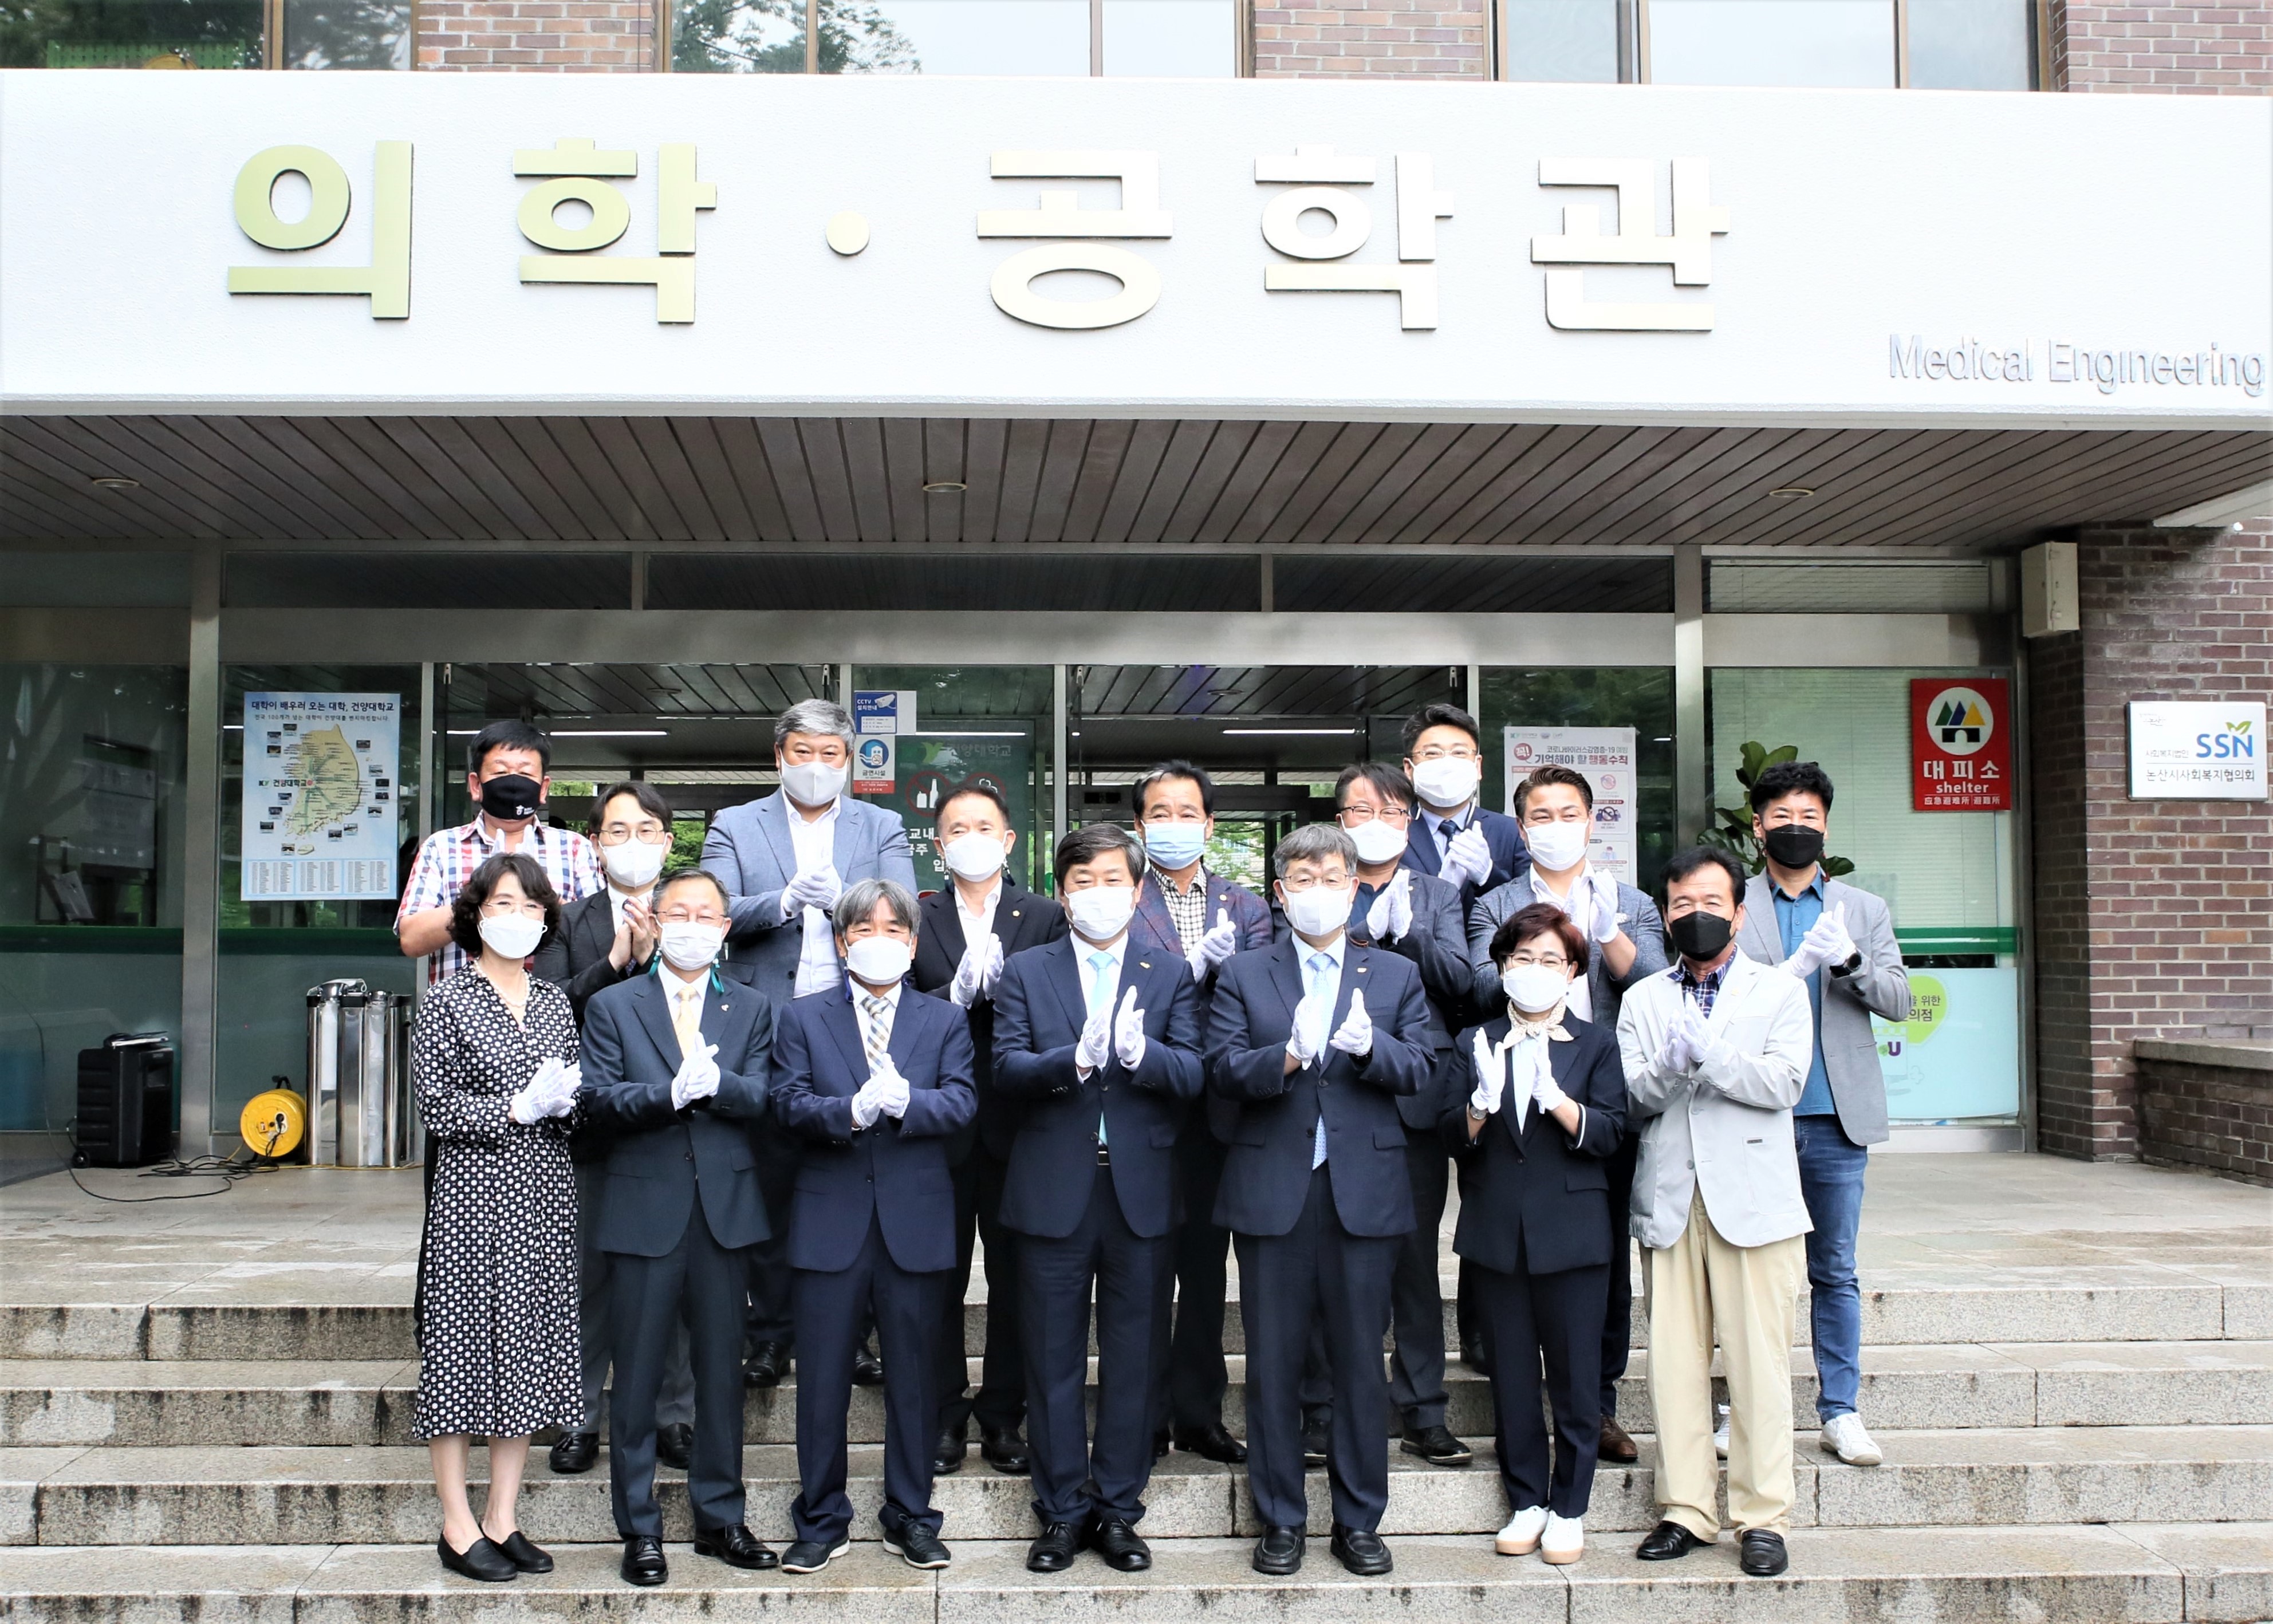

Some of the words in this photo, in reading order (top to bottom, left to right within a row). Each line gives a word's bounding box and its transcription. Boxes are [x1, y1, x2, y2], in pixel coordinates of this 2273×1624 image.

[1890, 334, 2034, 381] Medical
[2049, 338, 2266, 397] Engineering
[251, 701, 277, 711] 대학이
[280, 701, 306, 711] 배우러
[308, 701, 326, 711] 오는
[329, 702, 348, 712] 대학,
[351, 702, 395, 712] 건양대학교
[2196, 734, 2253, 758] SSN
[1535, 754, 1574, 764] 기억해야
[1577, 755, 1587, 764] 할
[1589, 755, 1628, 765] 행동수칙
[1923, 760, 2000, 780] 대피소
[2146, 769, 2255, 782] 논산시사회복지협의회
[1936, 781, 1989, 793] shelter
[908, 827, 935, 841] 교내
[1921, 995, 1941, 1006] 위한
[1901, 1008, 1932, 1022] 의점
